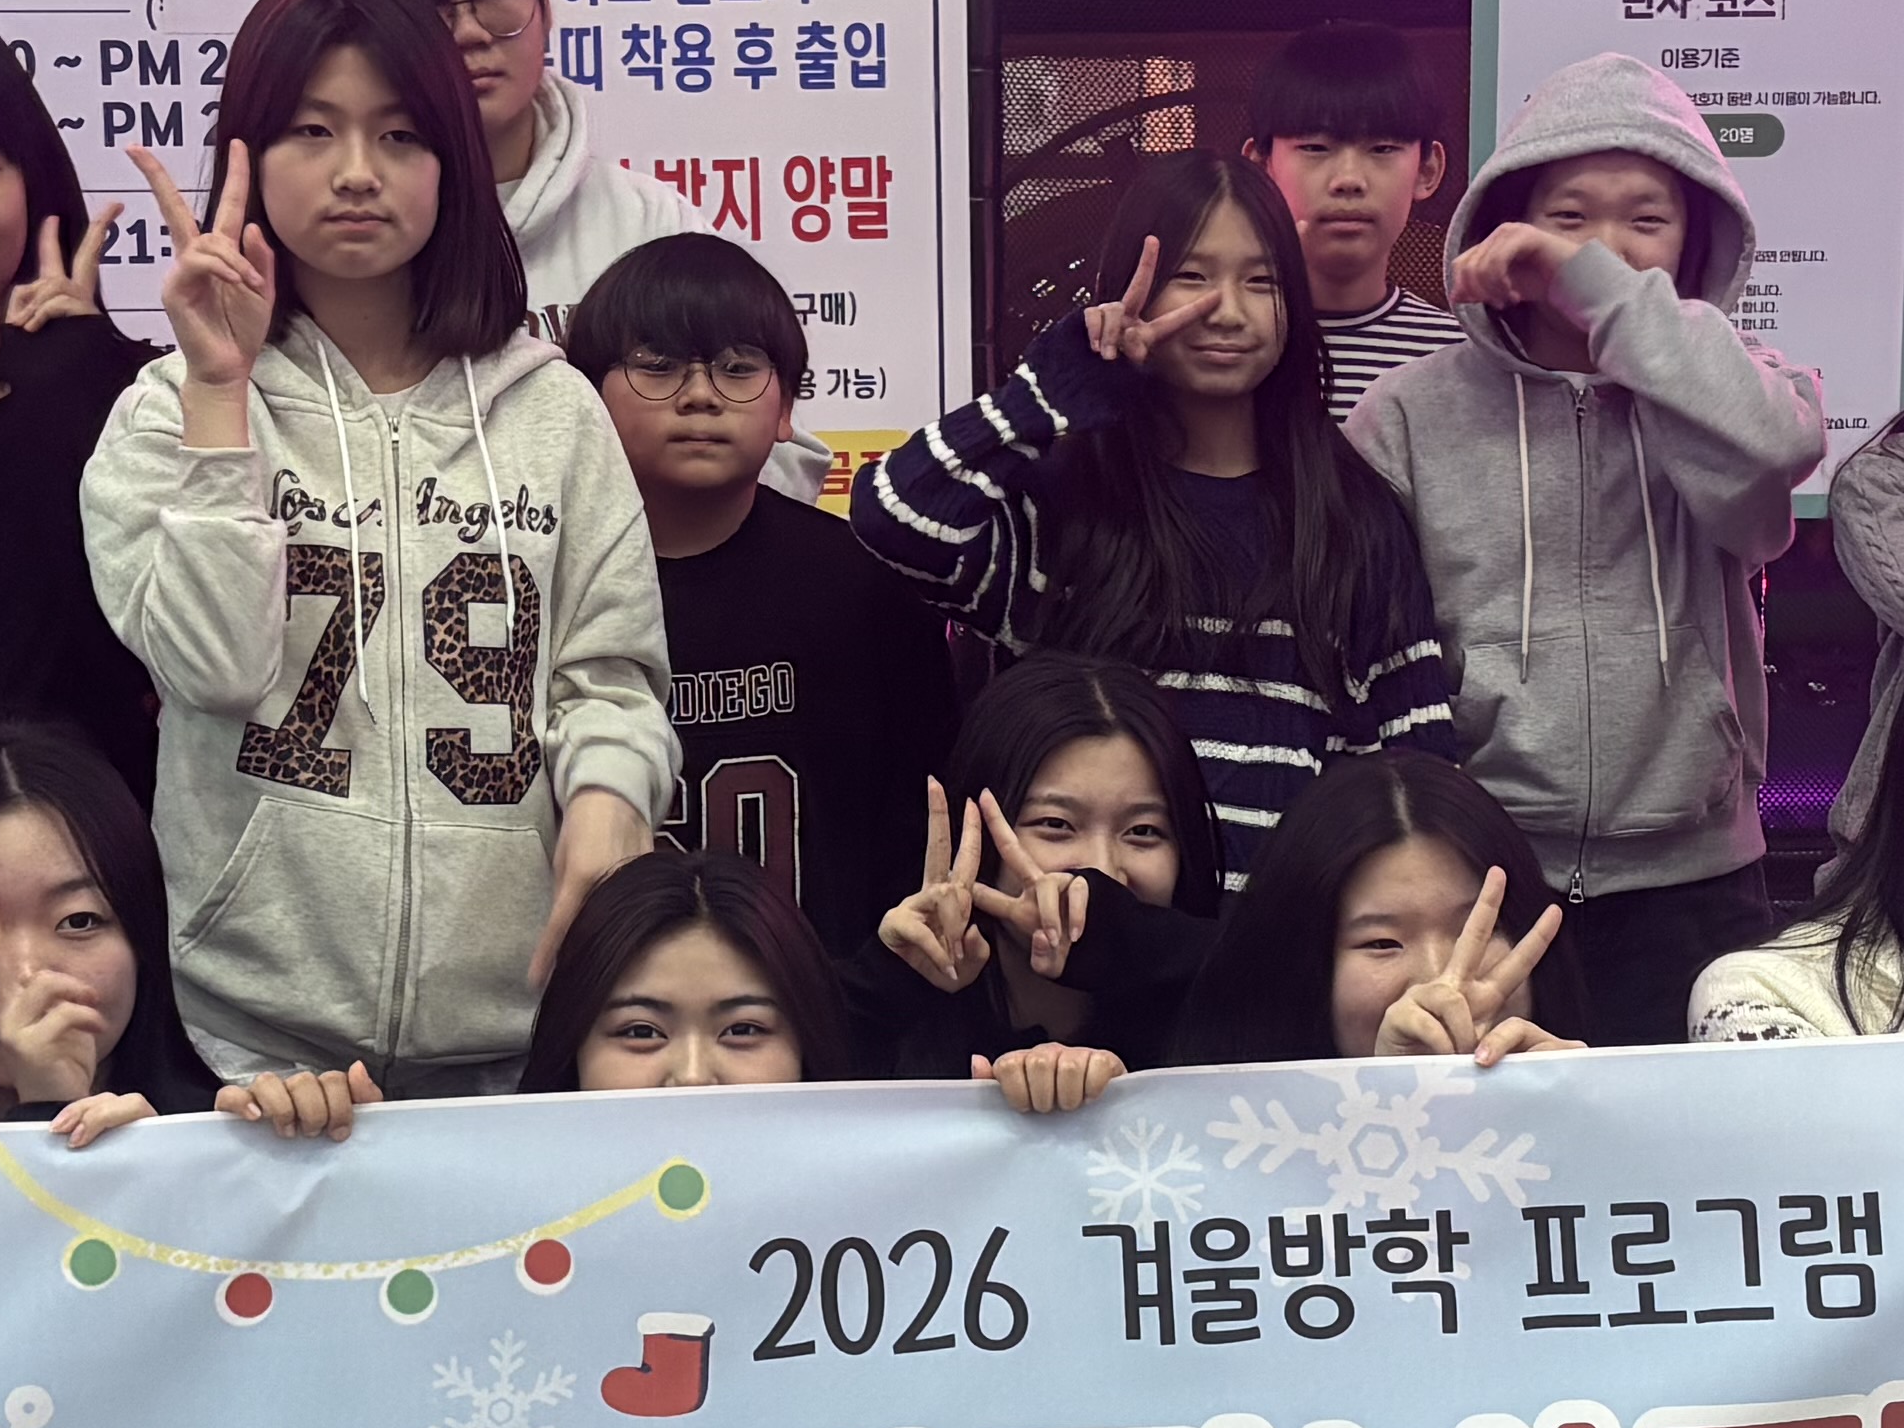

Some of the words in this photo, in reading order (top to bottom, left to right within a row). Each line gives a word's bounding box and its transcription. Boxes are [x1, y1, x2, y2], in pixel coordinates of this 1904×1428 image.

[100, 40, 180, 85] PM
[545, 25, 604, 92] 띠
[621, 24, 715, 92] 착용
[734, 22, 777, 89] 후
[795, 21, 885, 89] 출입
[1661, 48, 1740, 69] 이용기준
[1754, 91, 1770, 107] 시
[1812, 90, 1882, 106] 가능합니다.
[102, 101, 184, 148] PM
[1720, 128, 1753, 143] 20명
[784, 156, 892, 242] 양말
[827, 367, 886, 399] 가능)
[236, 544, 542, 806] 79
[671, 661, 795, 725] DIEGO
[749, 1227, 1028, 1361] 2026
[1082, 1209, 1469, 1345] 겨울방학
[1521, 1192, 1882, 1330] 프로그램
